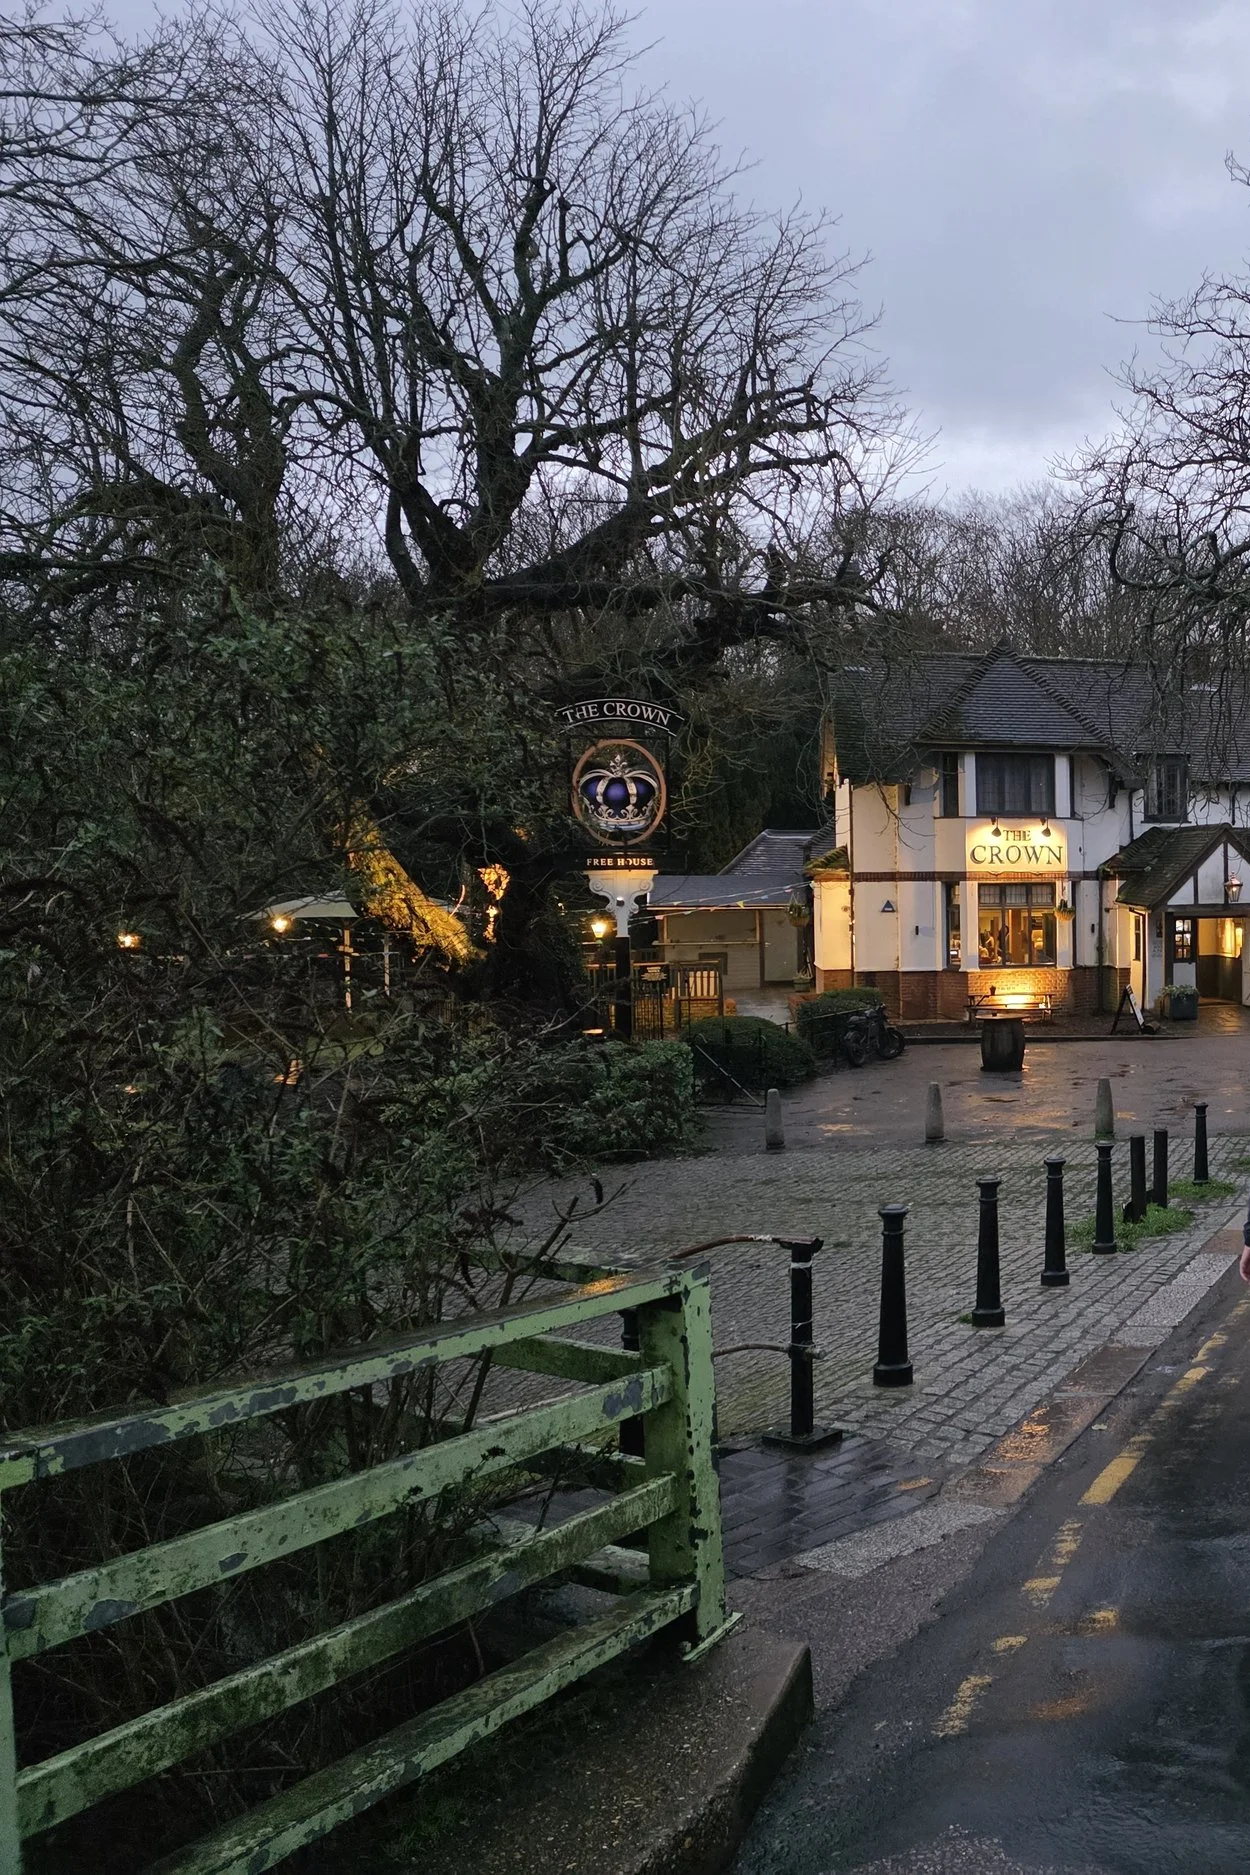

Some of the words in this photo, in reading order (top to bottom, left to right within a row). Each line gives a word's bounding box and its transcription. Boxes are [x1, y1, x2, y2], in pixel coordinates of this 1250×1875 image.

[563, 704, 599, 723] THE
[603, 702, 671, 726] CROWN
[1003, 830, 1031, 841] THE
[586, 858, 613, 866] FREE
[970, 845, 1063, 864] CROWN
